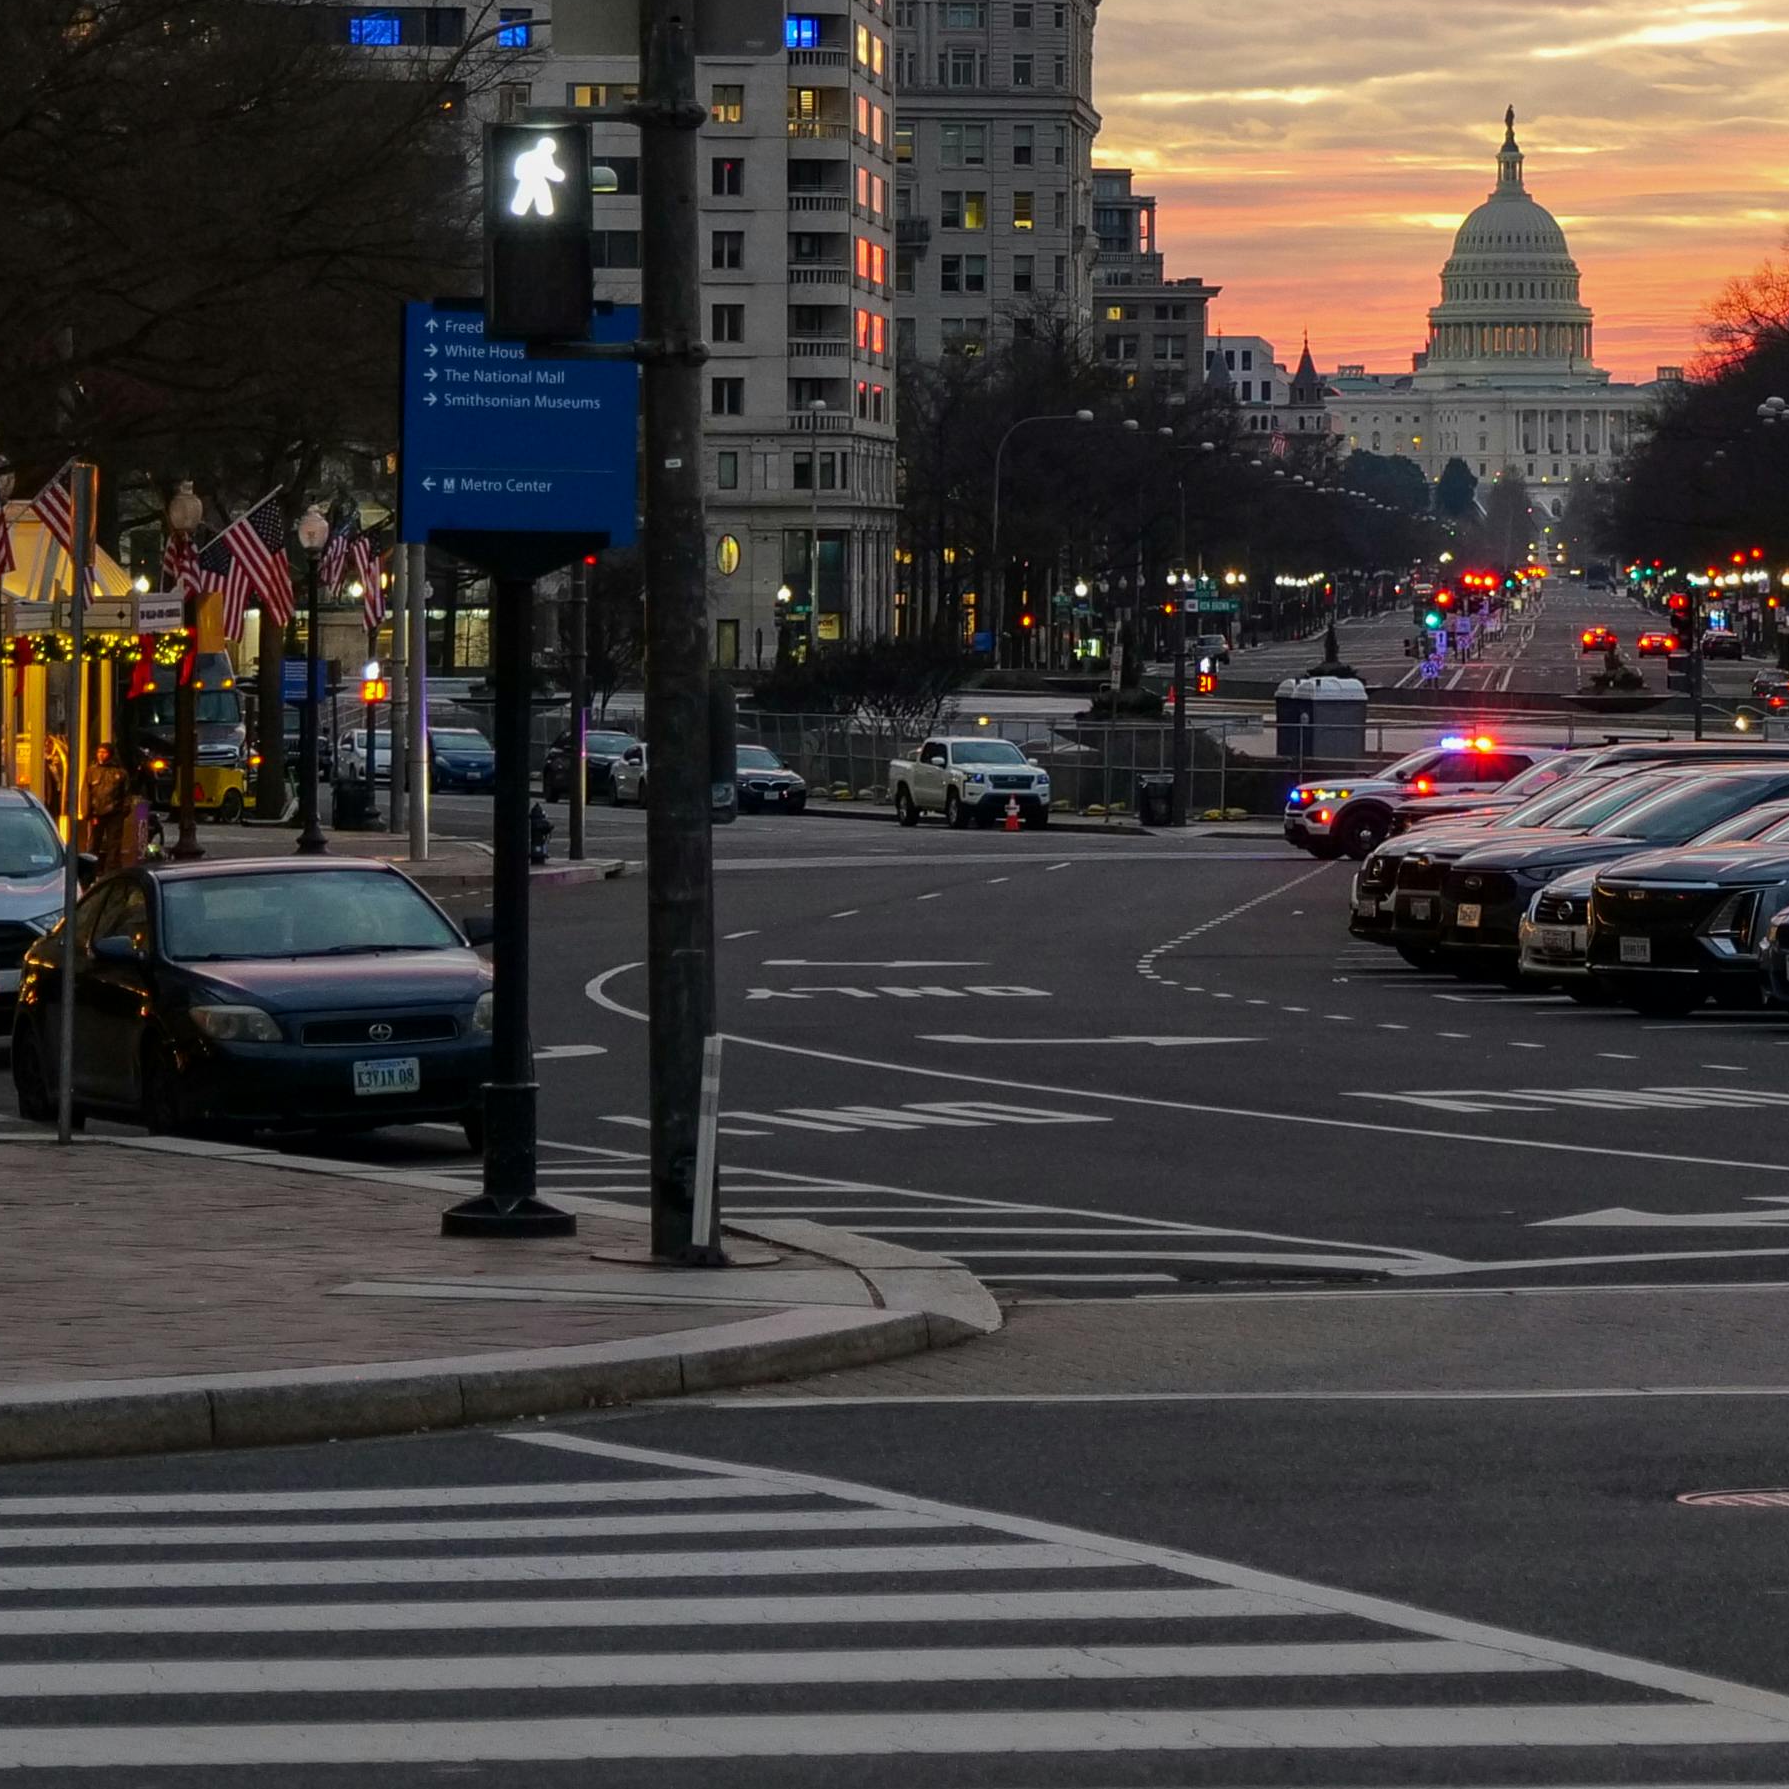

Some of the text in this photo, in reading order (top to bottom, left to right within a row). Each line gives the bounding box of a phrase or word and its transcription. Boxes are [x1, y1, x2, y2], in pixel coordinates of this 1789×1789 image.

[445, 320, 484, 334] Freed
[444, 345, 526, 360] White Hous
[444, 369, 565, 384] The National Mall
[444, 393, 601, 409] Smithsonian Museums
[460, 477, 503, 492] Metro
[505, 478, 553, 493] Center
[744, 985, 1054, 1000] ONLY
